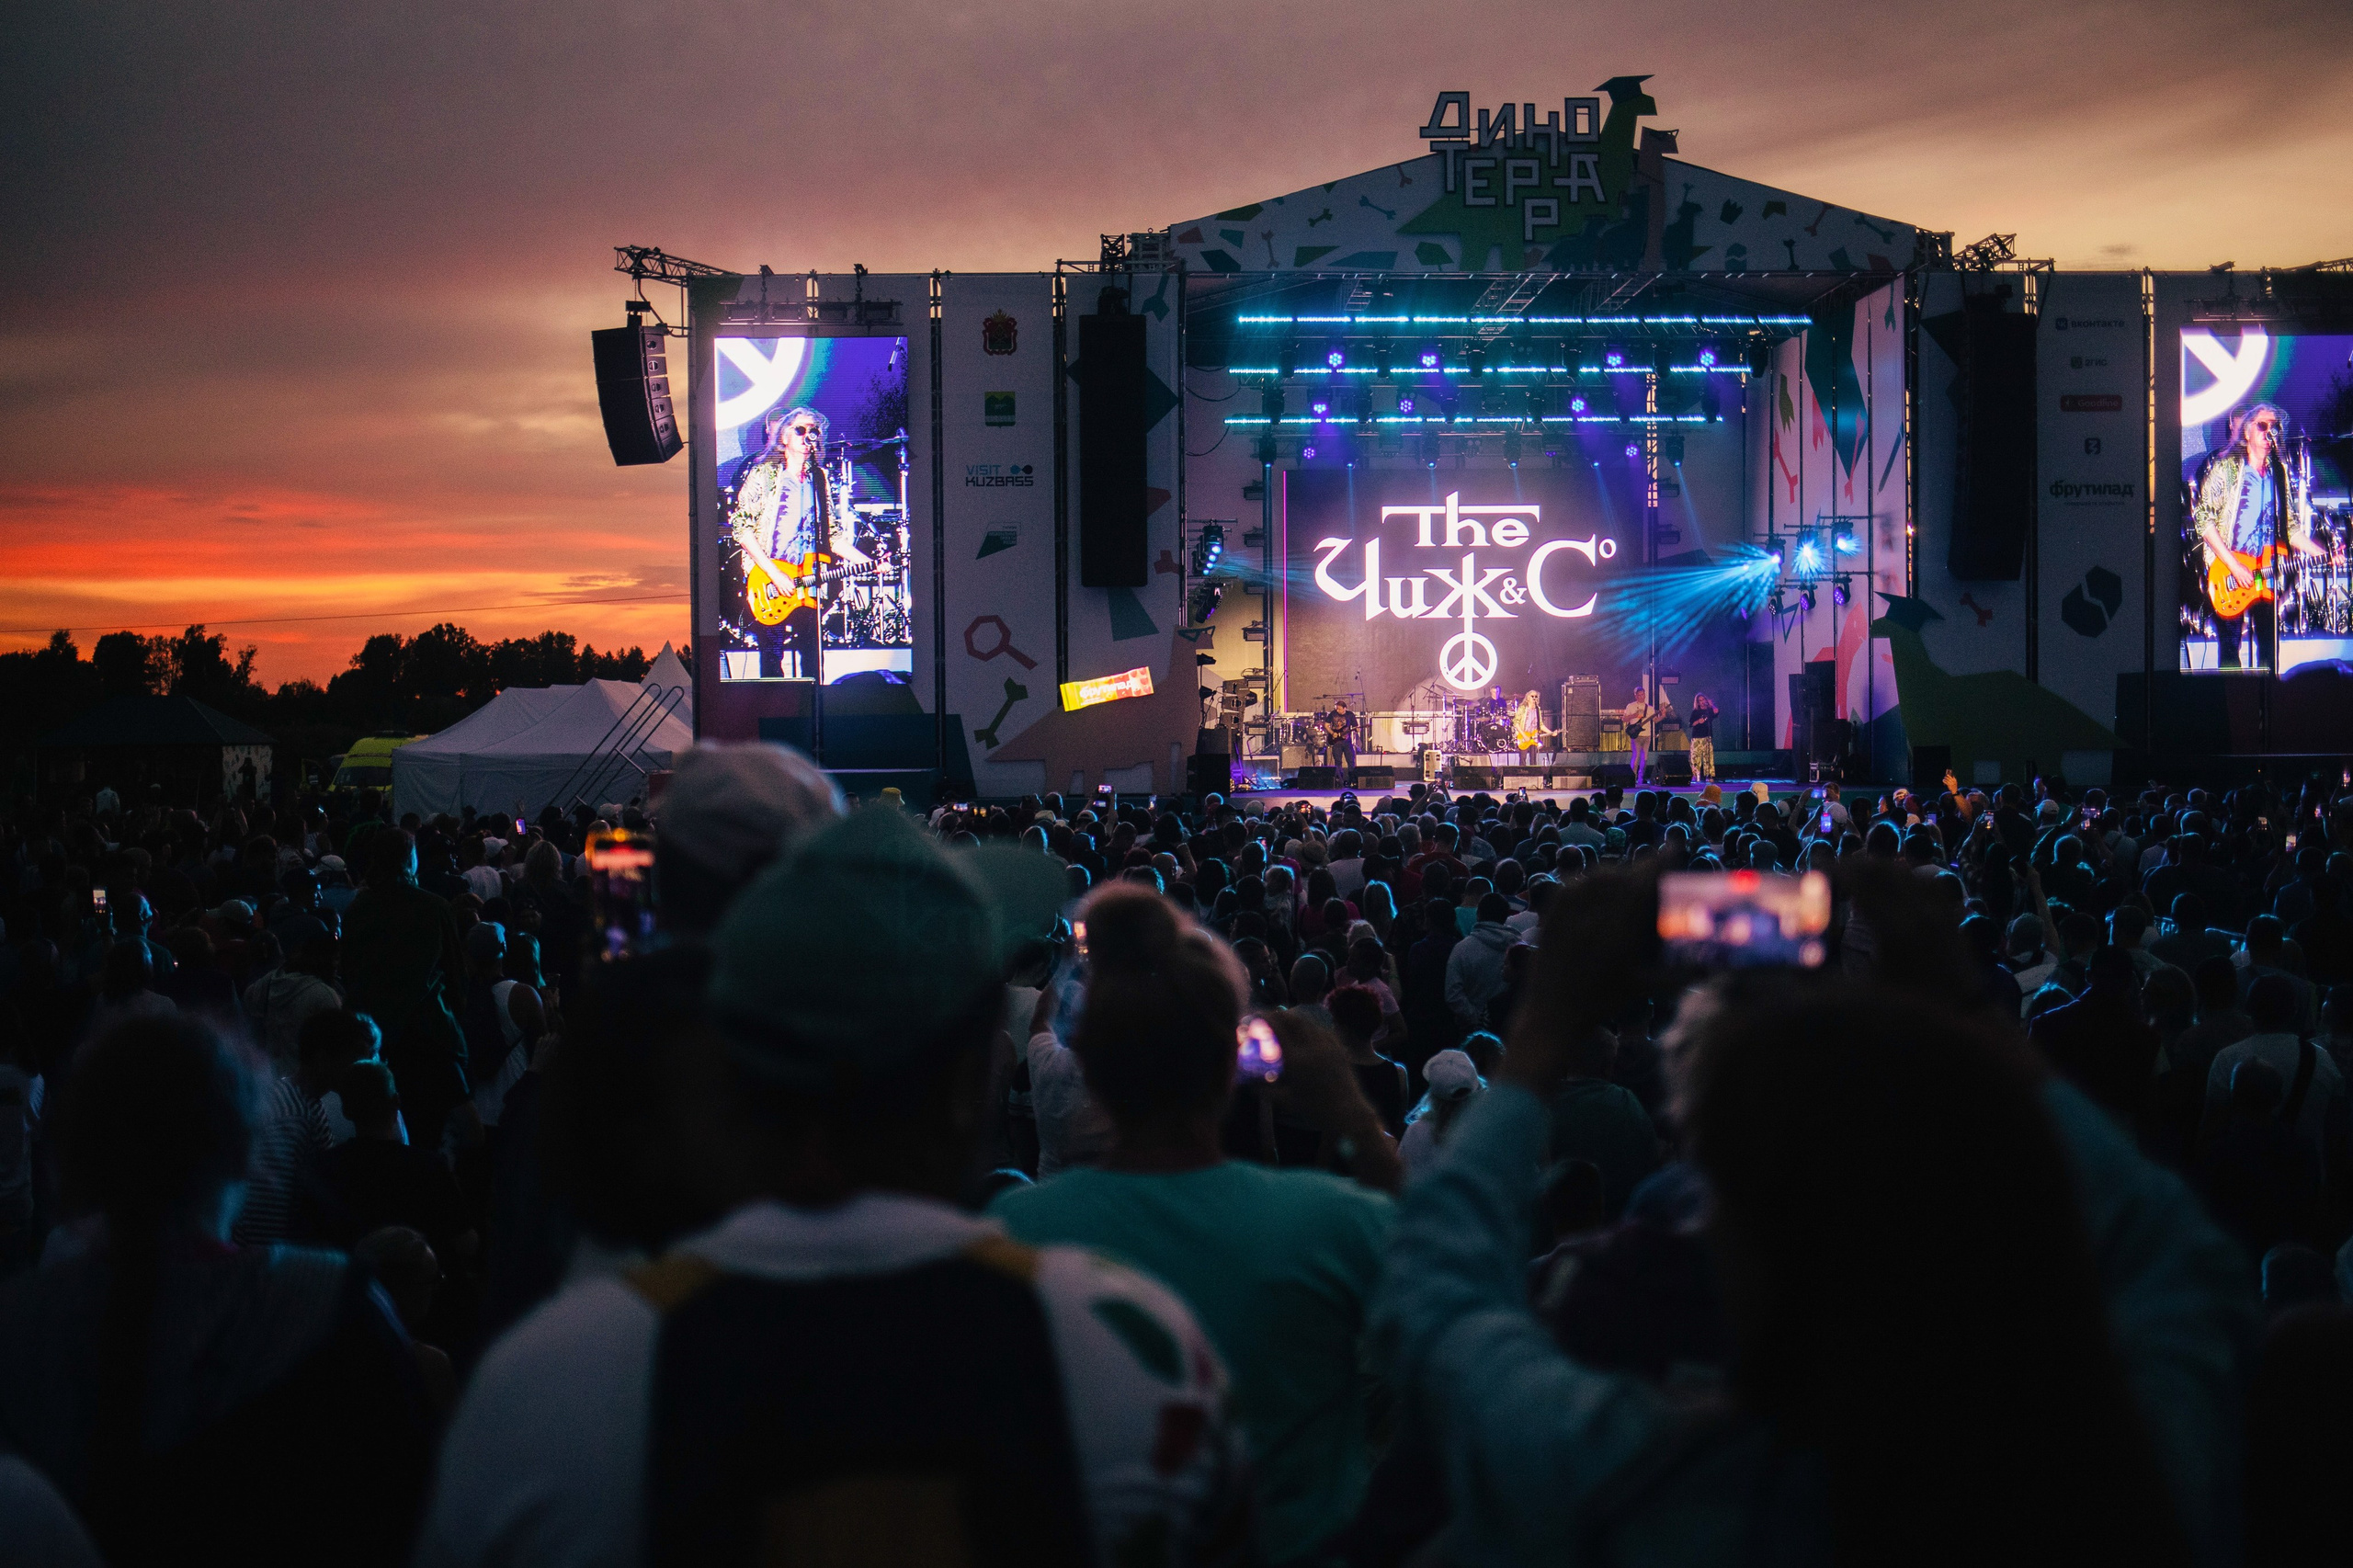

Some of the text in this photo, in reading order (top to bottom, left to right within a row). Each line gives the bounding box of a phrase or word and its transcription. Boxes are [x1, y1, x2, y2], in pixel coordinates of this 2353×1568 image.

[1419, 91, 1600, 167] ДИНО
[965, 476, 1034, 487] KUZBASS
[966, 464, 1001, 475] VISIT
[1381, 491, 1540, 547] The
